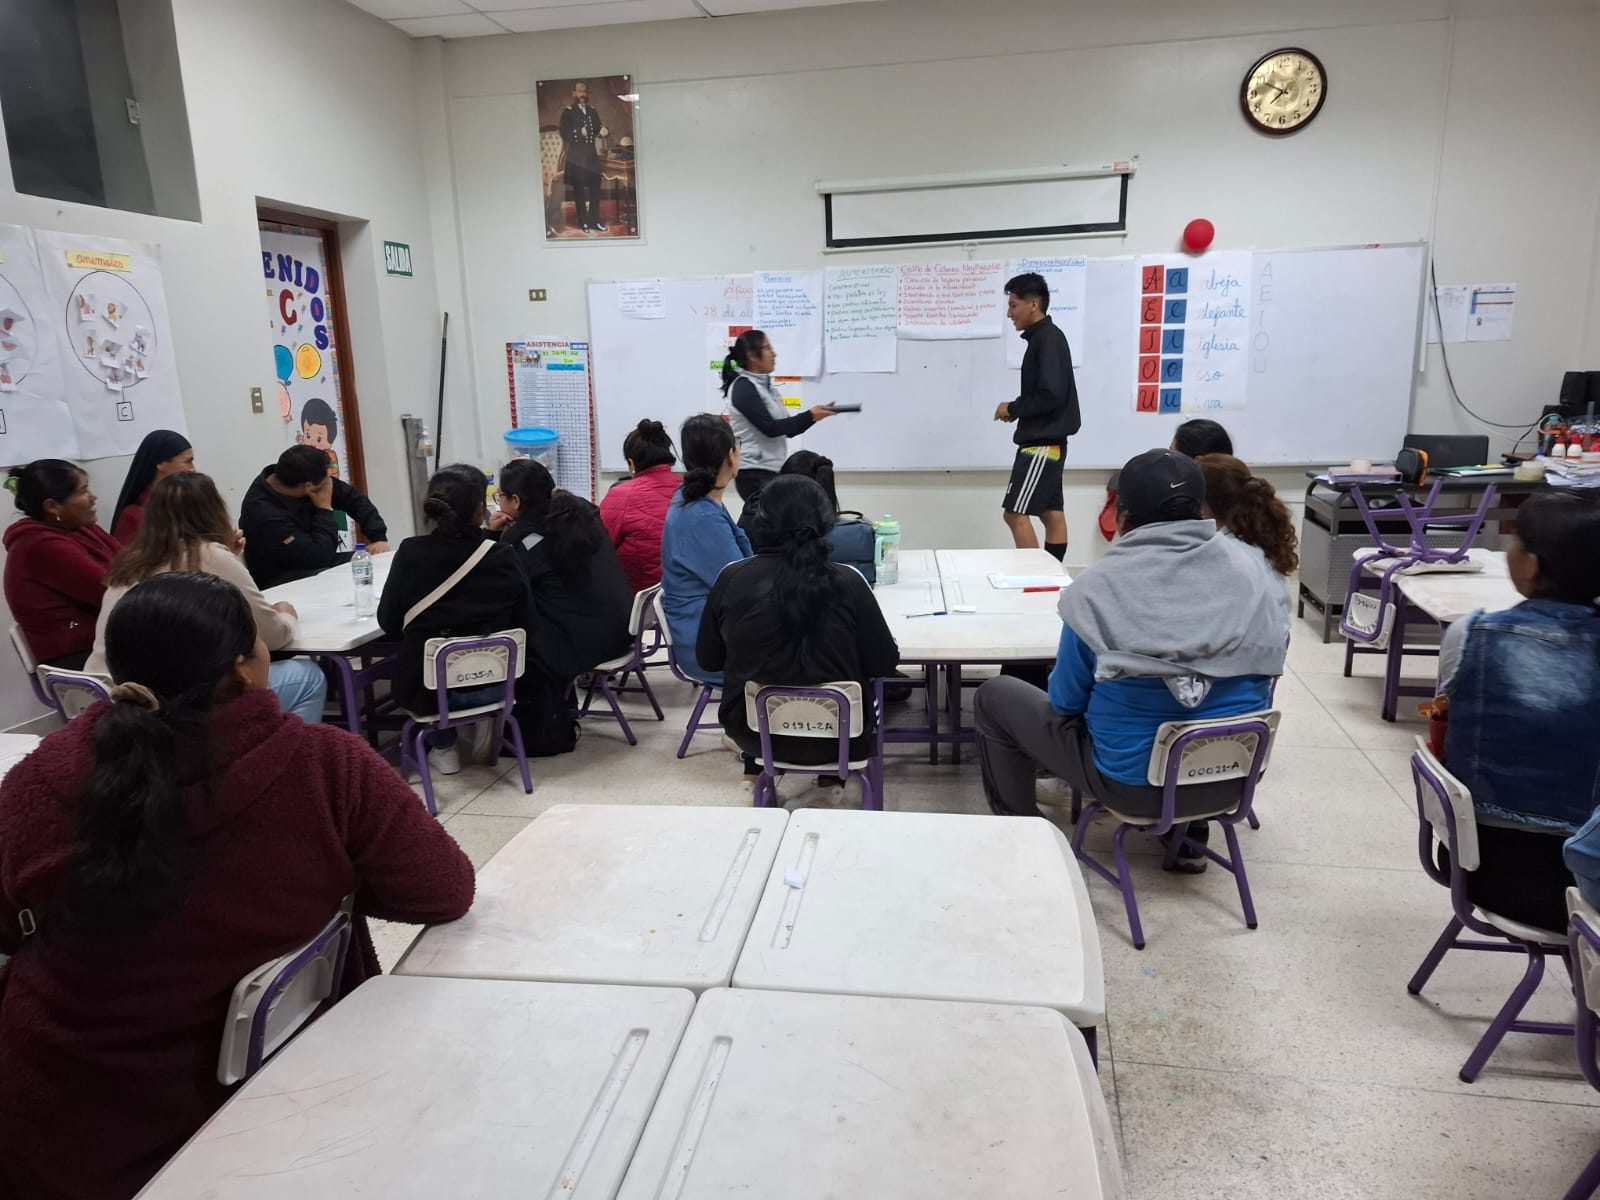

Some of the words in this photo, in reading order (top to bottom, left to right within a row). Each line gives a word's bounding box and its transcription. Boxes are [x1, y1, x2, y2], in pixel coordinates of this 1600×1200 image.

[1250, 90, 1258, 99] 9
[1254, 103, 1261, 112] 8
[1264, 112, 1271, 122] 7
[1279, 115, 1286, 124] 6
[1293, 110, 1301, 119] 5
[76, 255, 124, 268] animales
[385, 244, 412, 273] SALIDA
[1143, 267, 1160, 291] A
[1169, 271, 1186, 288] a
[1144, 299, 1158, 322] E
[1170, 302, 1183, 319] e
[1143, 359, 1156, 379] O
[1167, 362, 1181, 377] o
[1140, 389, 1155, 410] U
[1165, 394, 1179, 408] u
[121, 407, 129, 417] C
[1188, 761, 1240, 777] 00021-A
